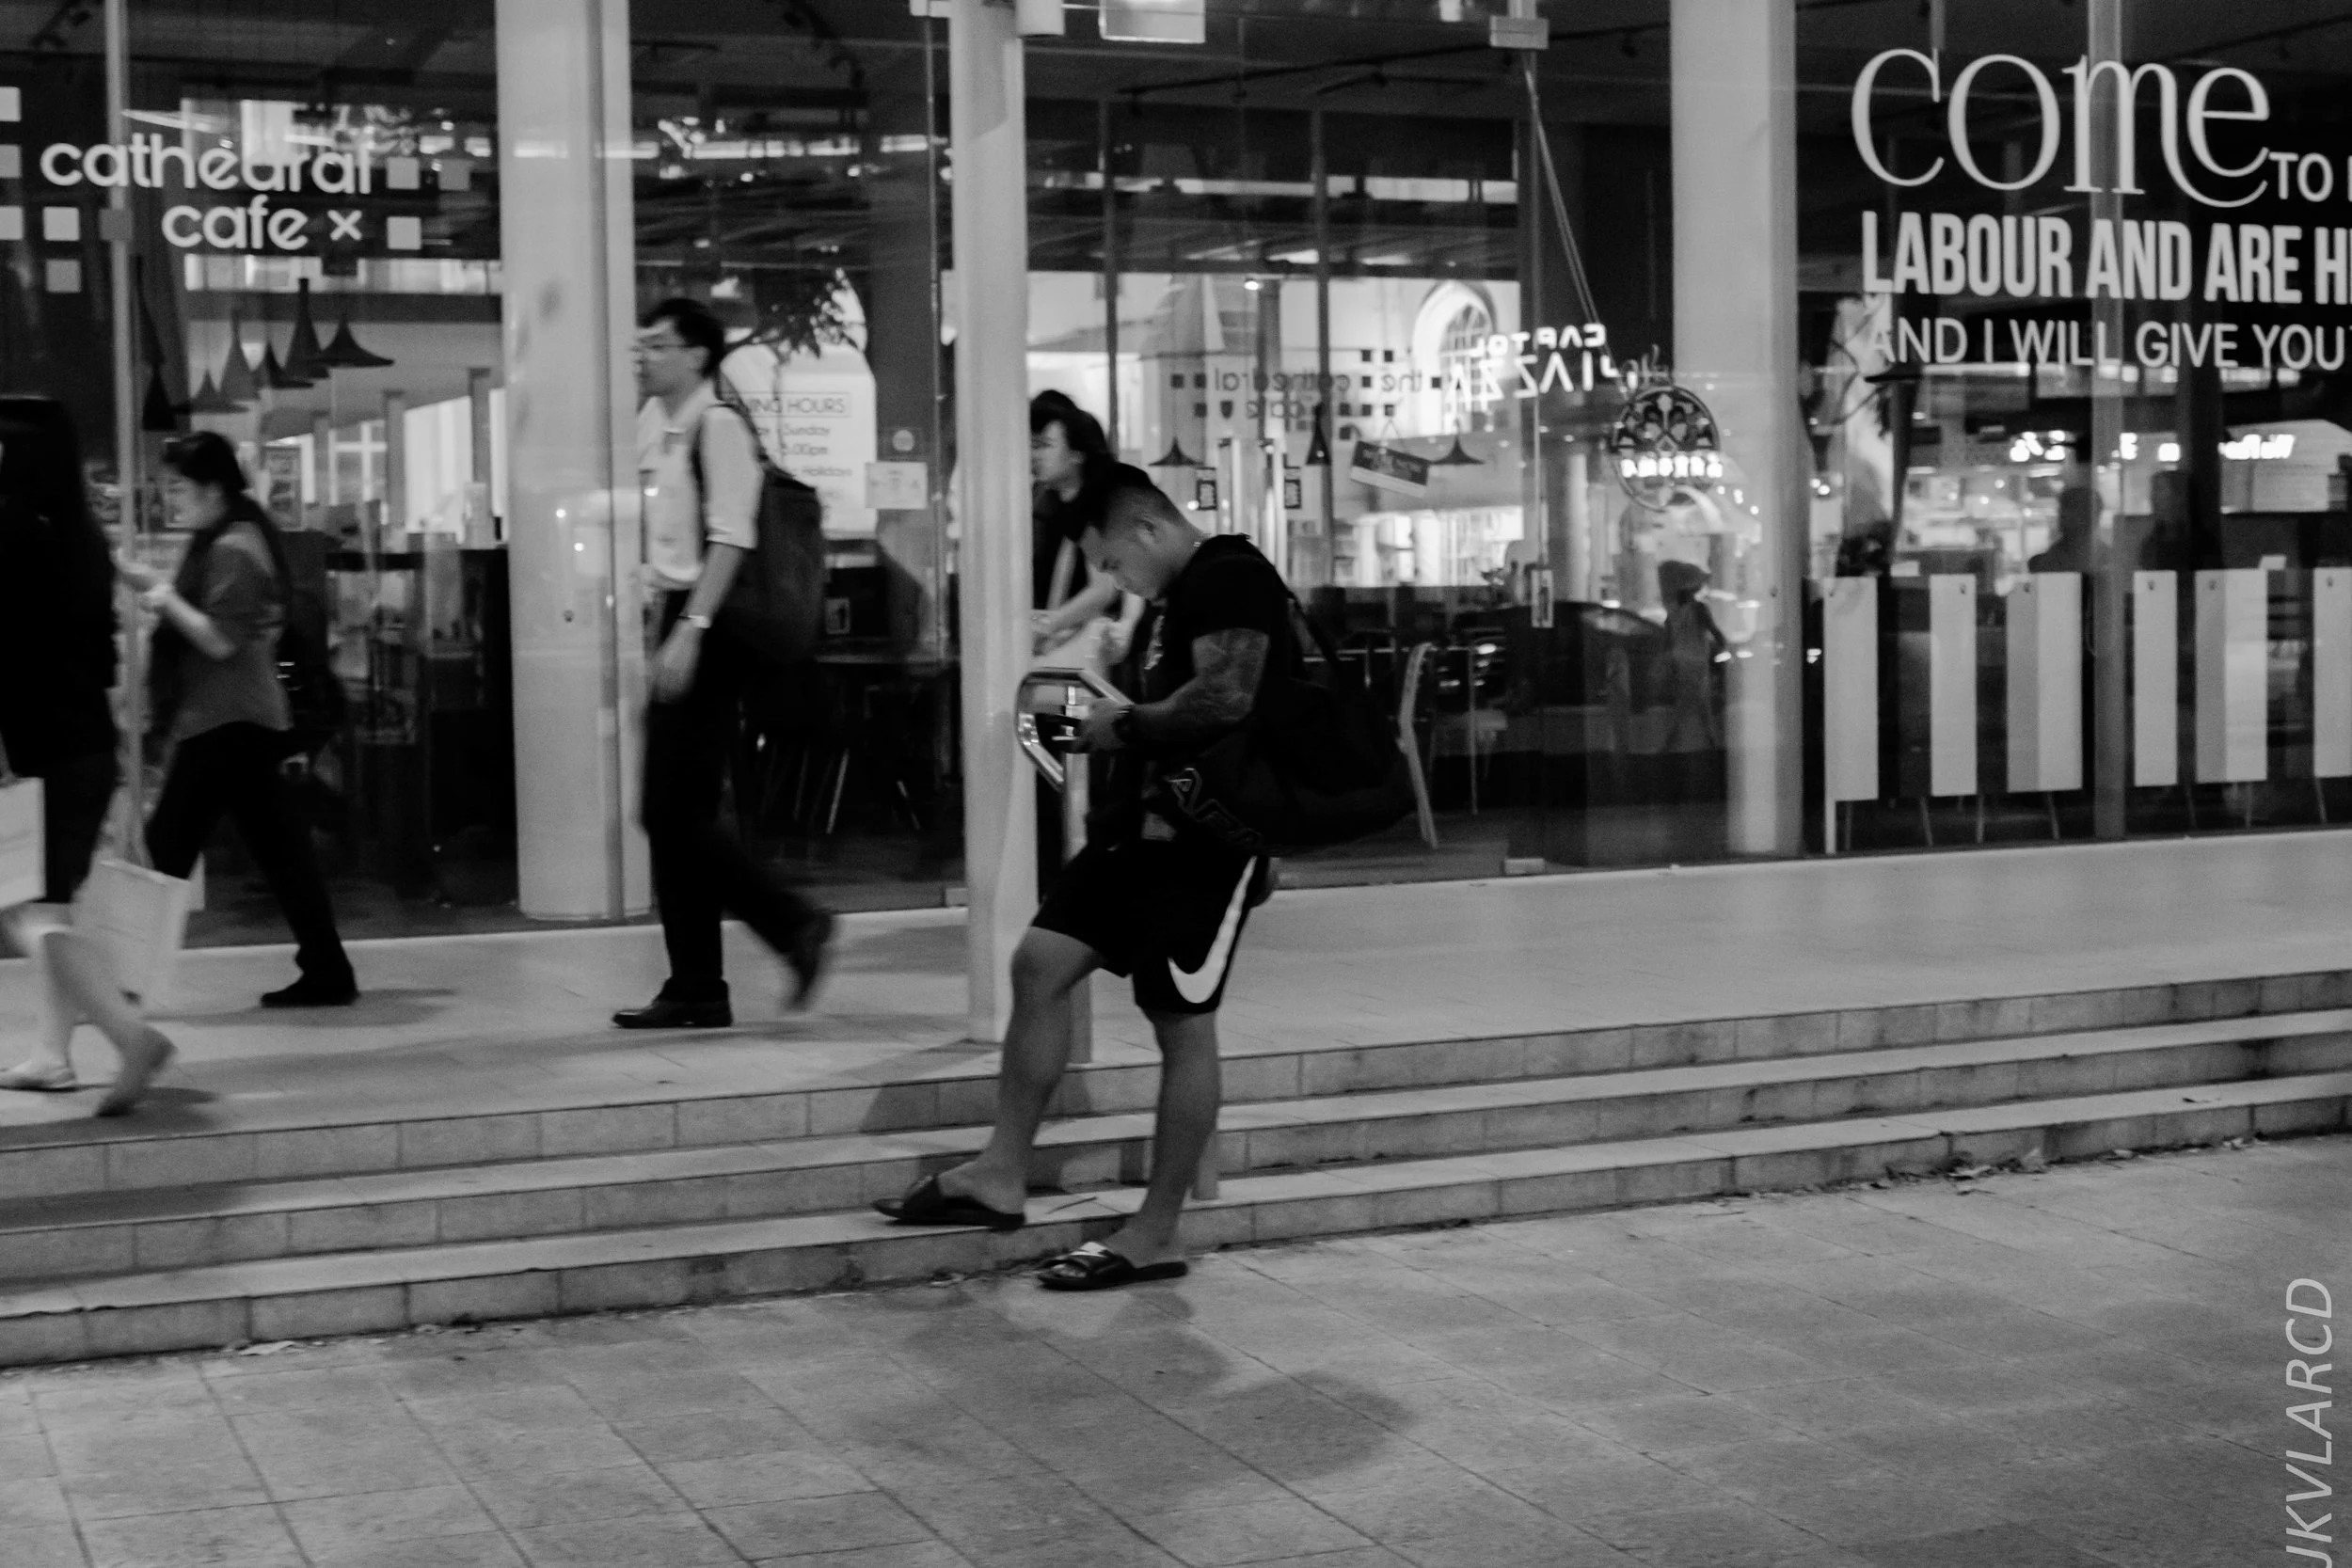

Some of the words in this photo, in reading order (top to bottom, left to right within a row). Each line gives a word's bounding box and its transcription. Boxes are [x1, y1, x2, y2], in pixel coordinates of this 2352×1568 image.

[40, 133, 371, 194] cathedral
[2268, 151, 2333, 202] TO
[162, 195, 308, 249] cafe
[1862, 211, 2072, 297] LABOUR
[2085, 219, 2191, 300] AND
[2204, 223, 2302, 304] ARE
[2313, 227, 2352, 304] H
[1868, 316, 1967, 363] AND
[1984, 318, 1994, 364] I
[2010, 318, 2122, 367] WILL
[2135, 321, 2238, 368] GIVE
[2251, 324, 2344, 371] YOU
[787, 398, 844, 414] HOURS
